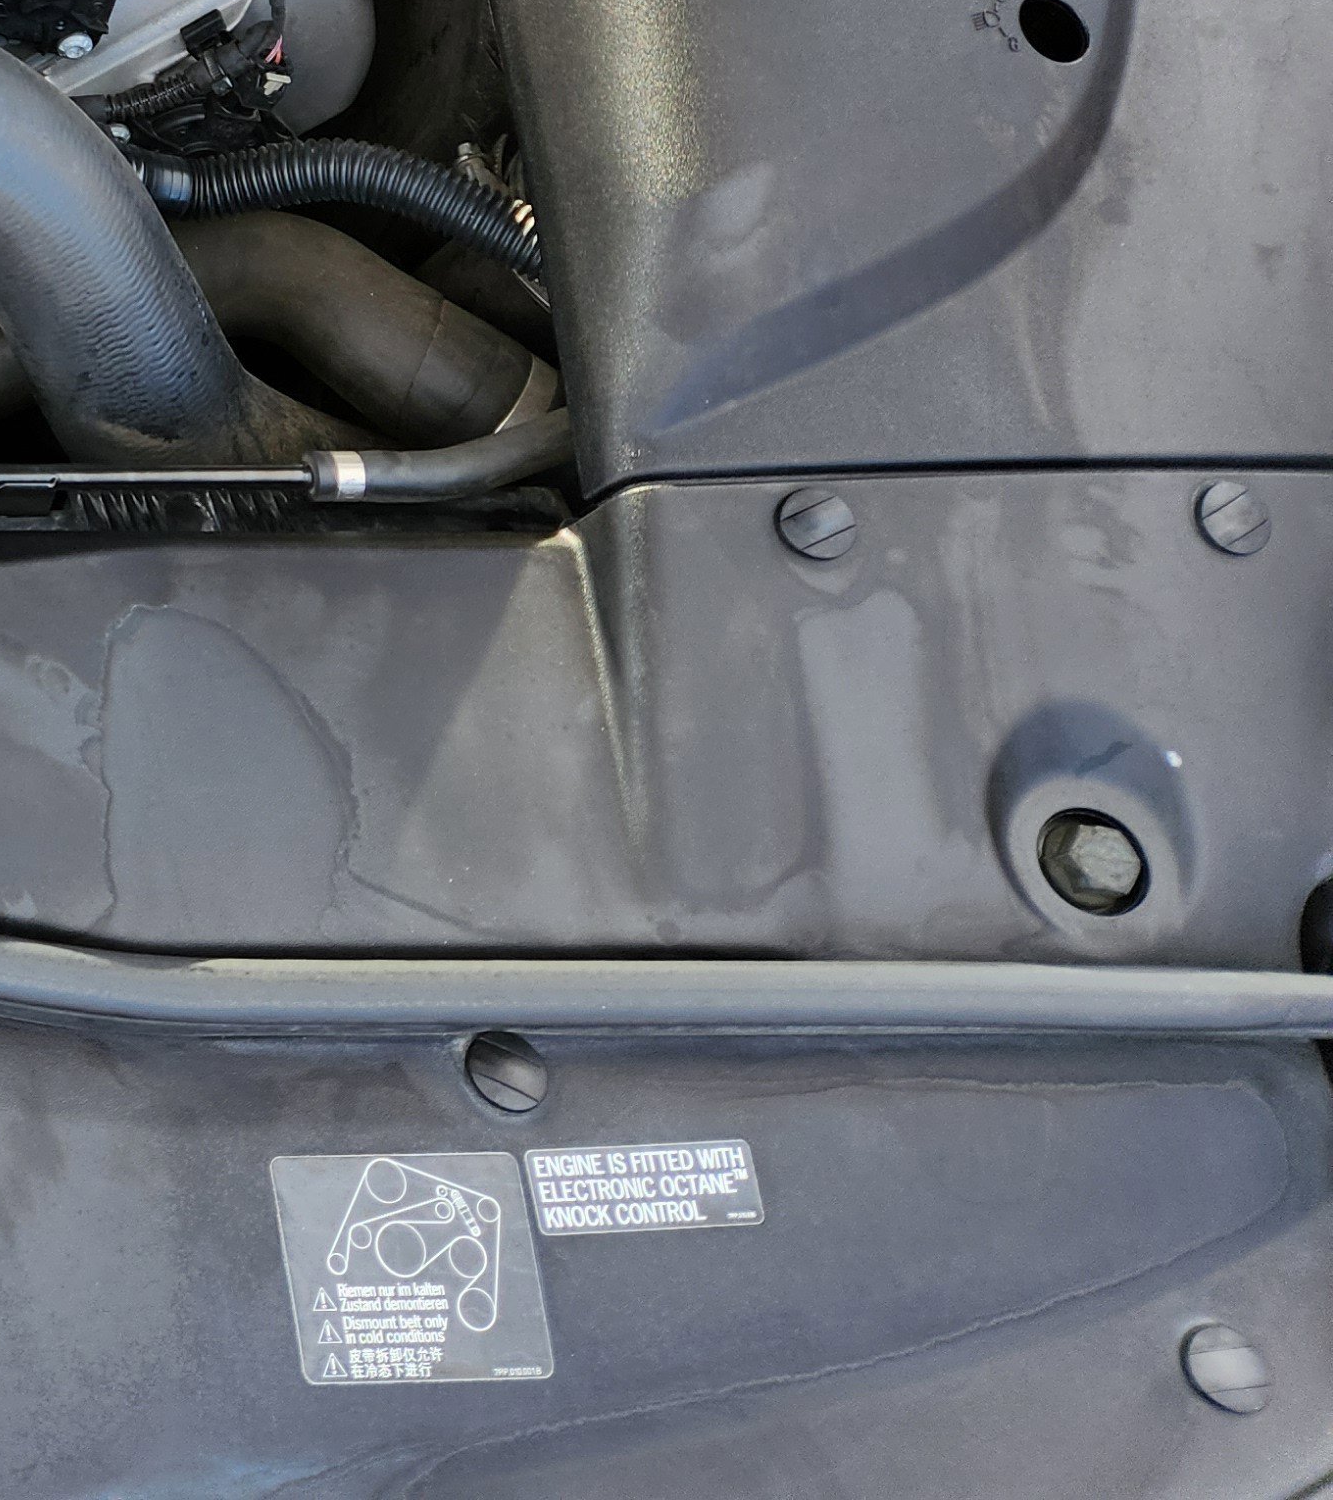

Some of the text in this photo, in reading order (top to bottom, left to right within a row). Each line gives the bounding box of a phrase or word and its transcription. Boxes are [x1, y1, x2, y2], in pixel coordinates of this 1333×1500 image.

[533, 1147, 745, 1177] ENGINE IS FITTED WITH
[538, 1176, 656, 1203] ELECTRONIC
[544, 1200, 708, 1228] KNOCK CONTROL
[336, 1282, 445, 1298] Riemen nur im kalten
[340, 1297, 449, 1312] Zustand demontieren
[342, 1314, 449, 1331] Dismount belt only
[345, 1328, 445, 1344] in cold conditions
